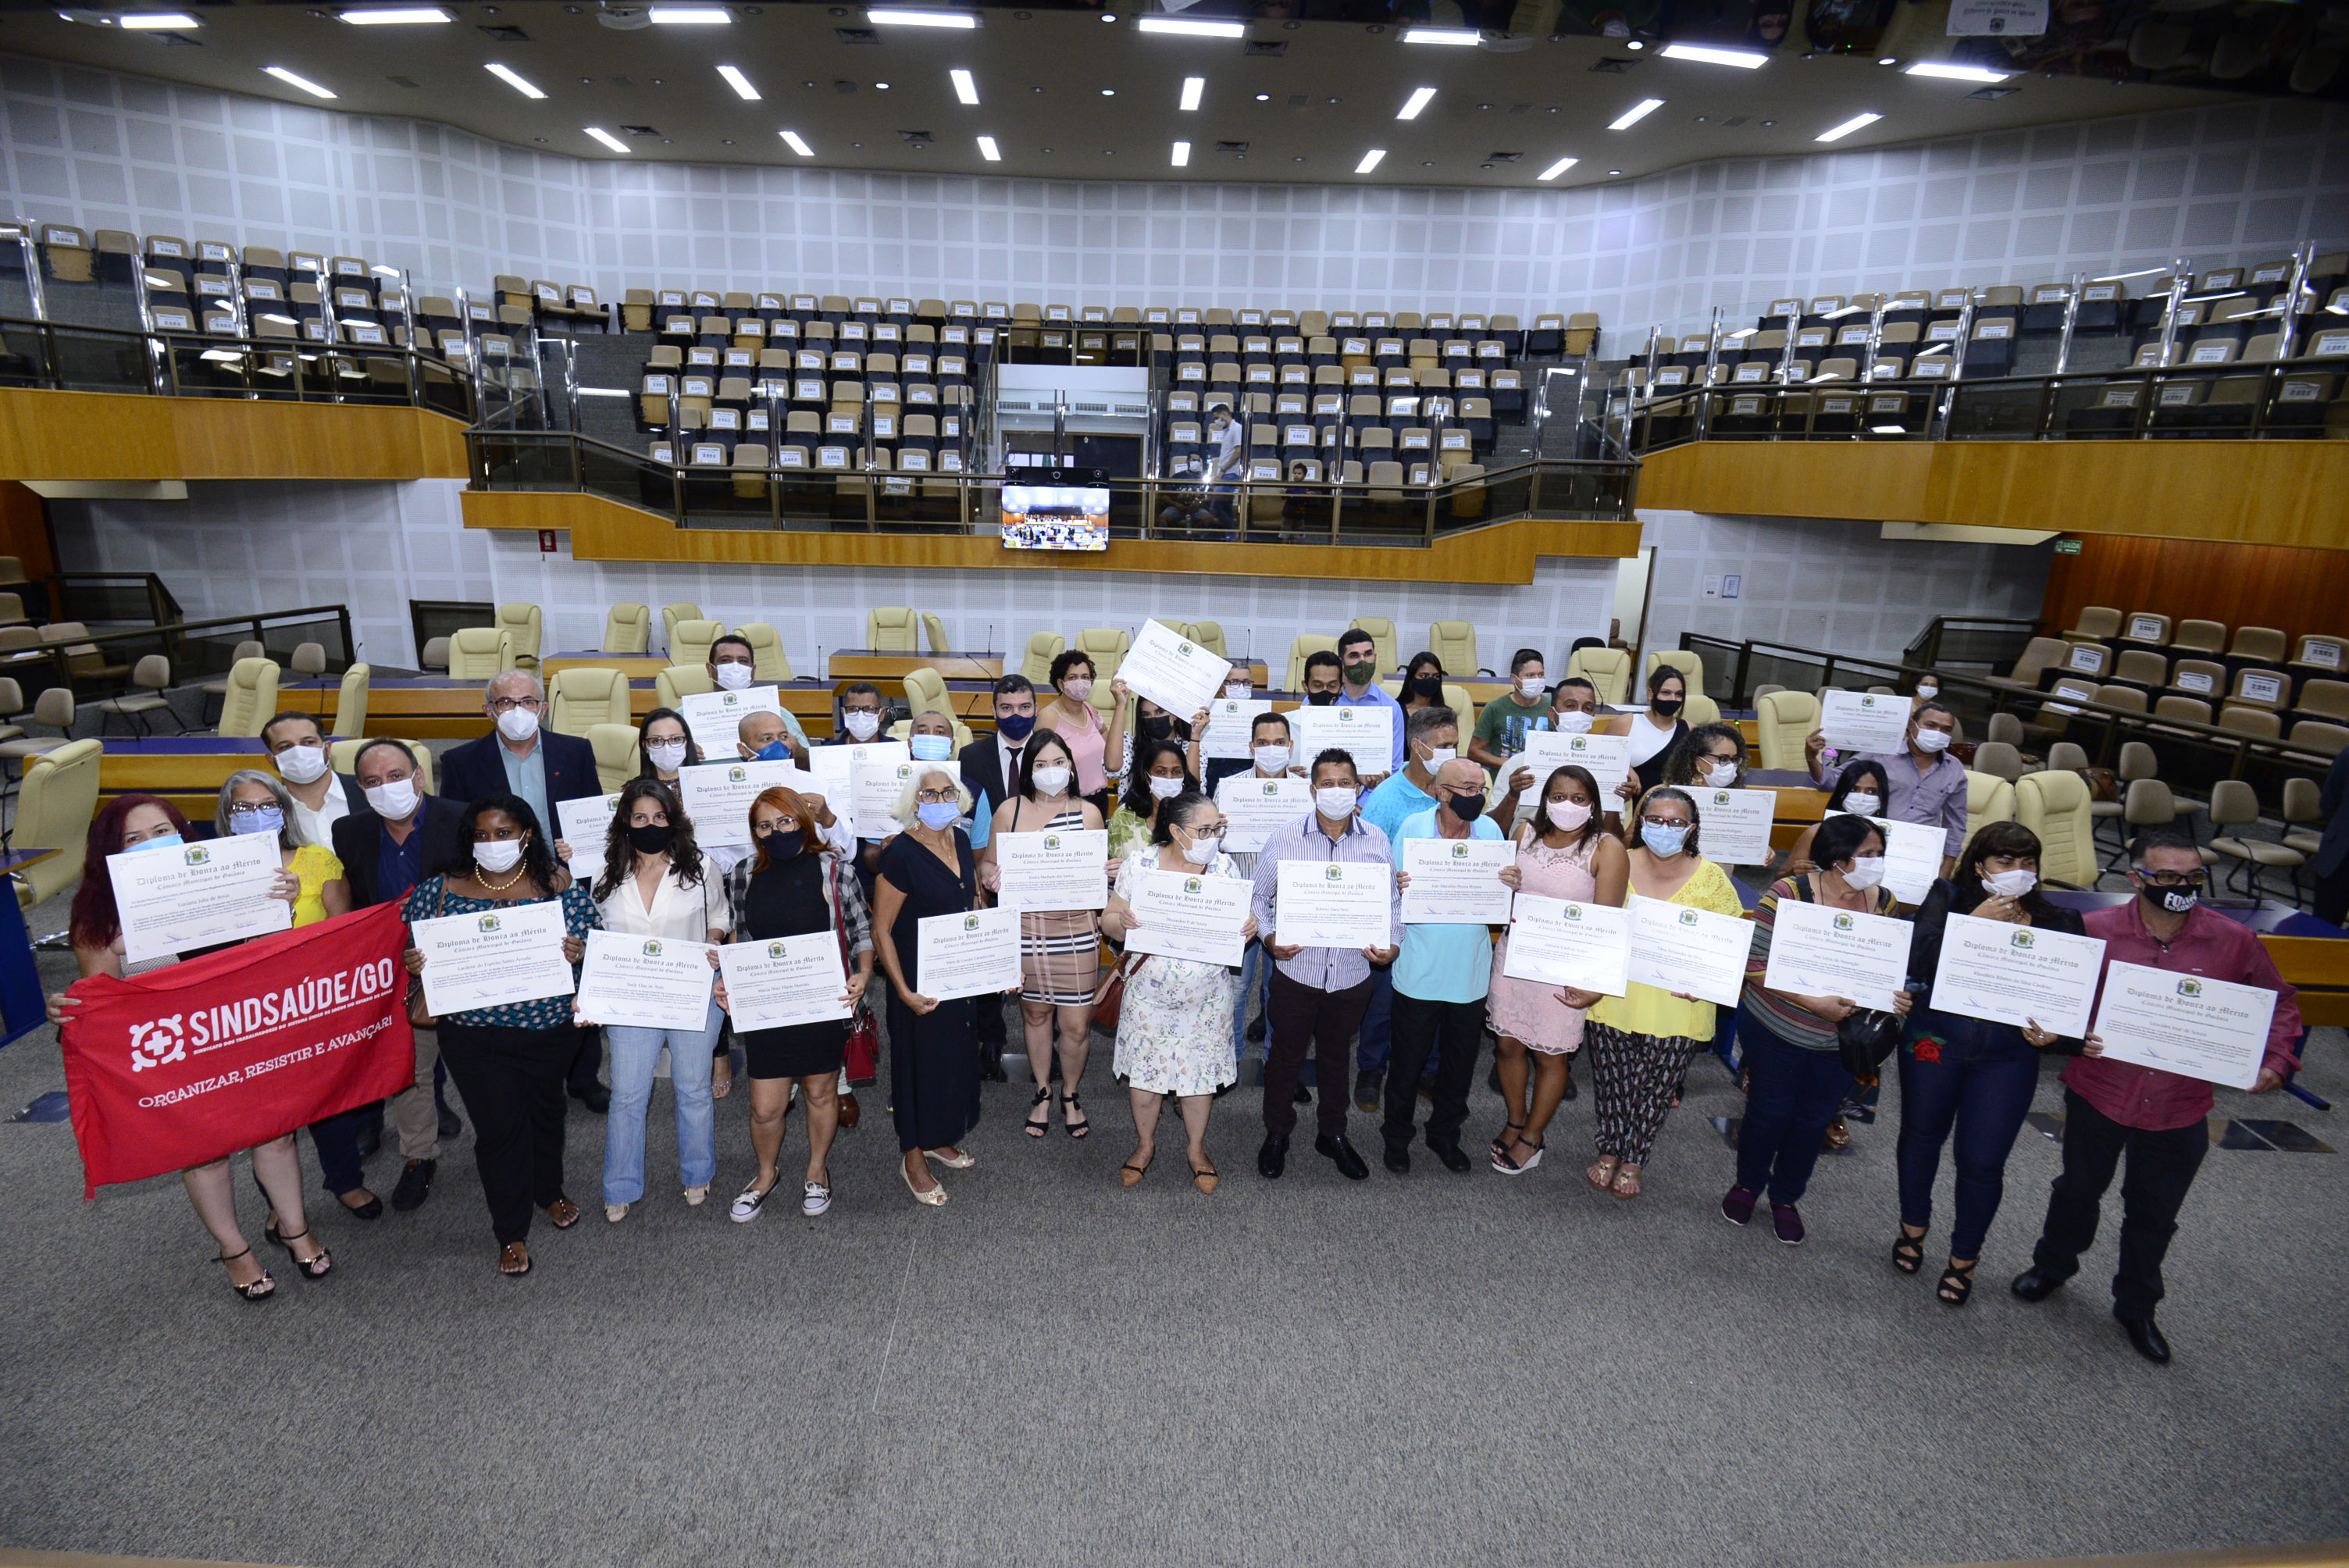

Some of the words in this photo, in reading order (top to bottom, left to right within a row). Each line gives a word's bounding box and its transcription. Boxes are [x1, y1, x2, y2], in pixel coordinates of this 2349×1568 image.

[135, 874, 176, 886] Diploma
[189, 866, 218, 876] Honra
[232, 858, 261, 870] Mérito
[1146, 889, 1174, 900] Diploma
[1183, 894, 1203, 903] Honra
[1213, 898, 1235, 907] Mérito
[990, 928, 1009, 936] Mérito
[1527, 914, 1553, 925] Diploma
[1563, 920, 1584, 929] Honra
[1594, 925, 1616, 935] Mérito
[1792, 923, 1822, 935] Diploma
[1832, 930, 1855, 941] Honra
[1866, 937, 1892, 948] Mérito
[435, 939, 470, 949] Diploma
[482, 933, 508, 943] Honra
[520, 927, 547, 937] Mérito
[602, 953, 632, 963] Diploma
[642, 957, 665, 966] Honra
[675, 960, 698, 970] Mérito
[735, 964, 763, 972] Diploma
[802, 955, 825, 964] Mérito
[1962, 939, 1997, 953] Diploma
[2009, 948, 2036, 960] Honra
[2048, 956, 2079, 968] Mérito
[189, 957, 394, 1046] SINDSAÚDE/GO
[2126, 986, 2162, 1001] Diploma
[2176, 996, 2204, 1010] Honra
[2217, 1007, 2249, 1018] Mérito
[194, 1042, 223, 1054] SINDICATO
[236, 1027, 278, 1043] TRABALHADORES
[287, 1017, 308, 1027] SISTEMA
[308, 1011, 323, 1021] ÚNICO
[331, 1004, 347, 1014] SAÚDE
[355, 996, 373, 1006] ESTADO
[381, 989, 394, 997] GOIÁS
[138, 1071, 244, 1109] ORGANIZAR,
[244, 1046, 313, 1079] RESISTIR
[315, 1042, 325, 1056] E
[326, 1015, 393, 1053] AVANÇAR!
